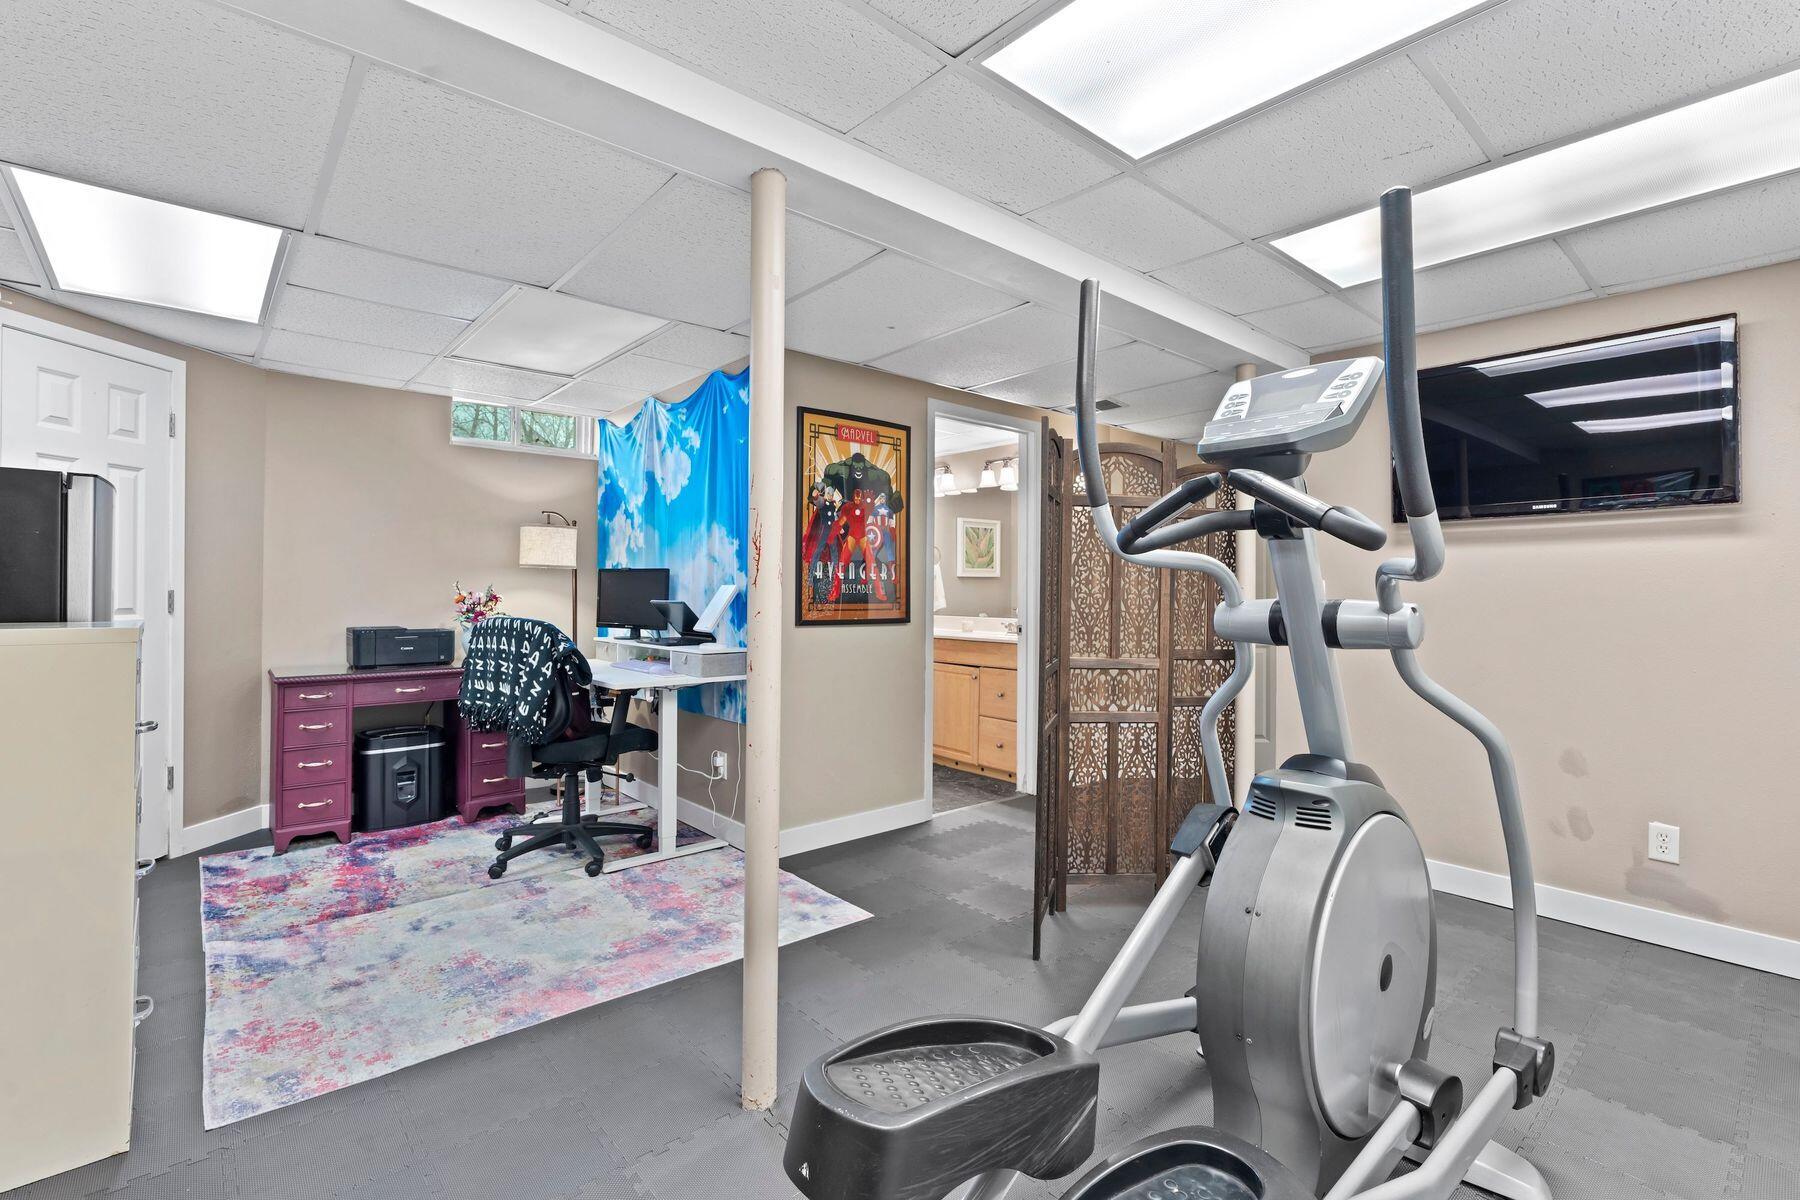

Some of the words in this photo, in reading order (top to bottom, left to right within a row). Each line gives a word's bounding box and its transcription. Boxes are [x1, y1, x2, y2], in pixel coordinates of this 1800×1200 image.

[841, 427, 874, 443] MARVEL
[815, 561, 896, 581] AVENGERS
[841, 583, 874, 595] ASSEMBLE
